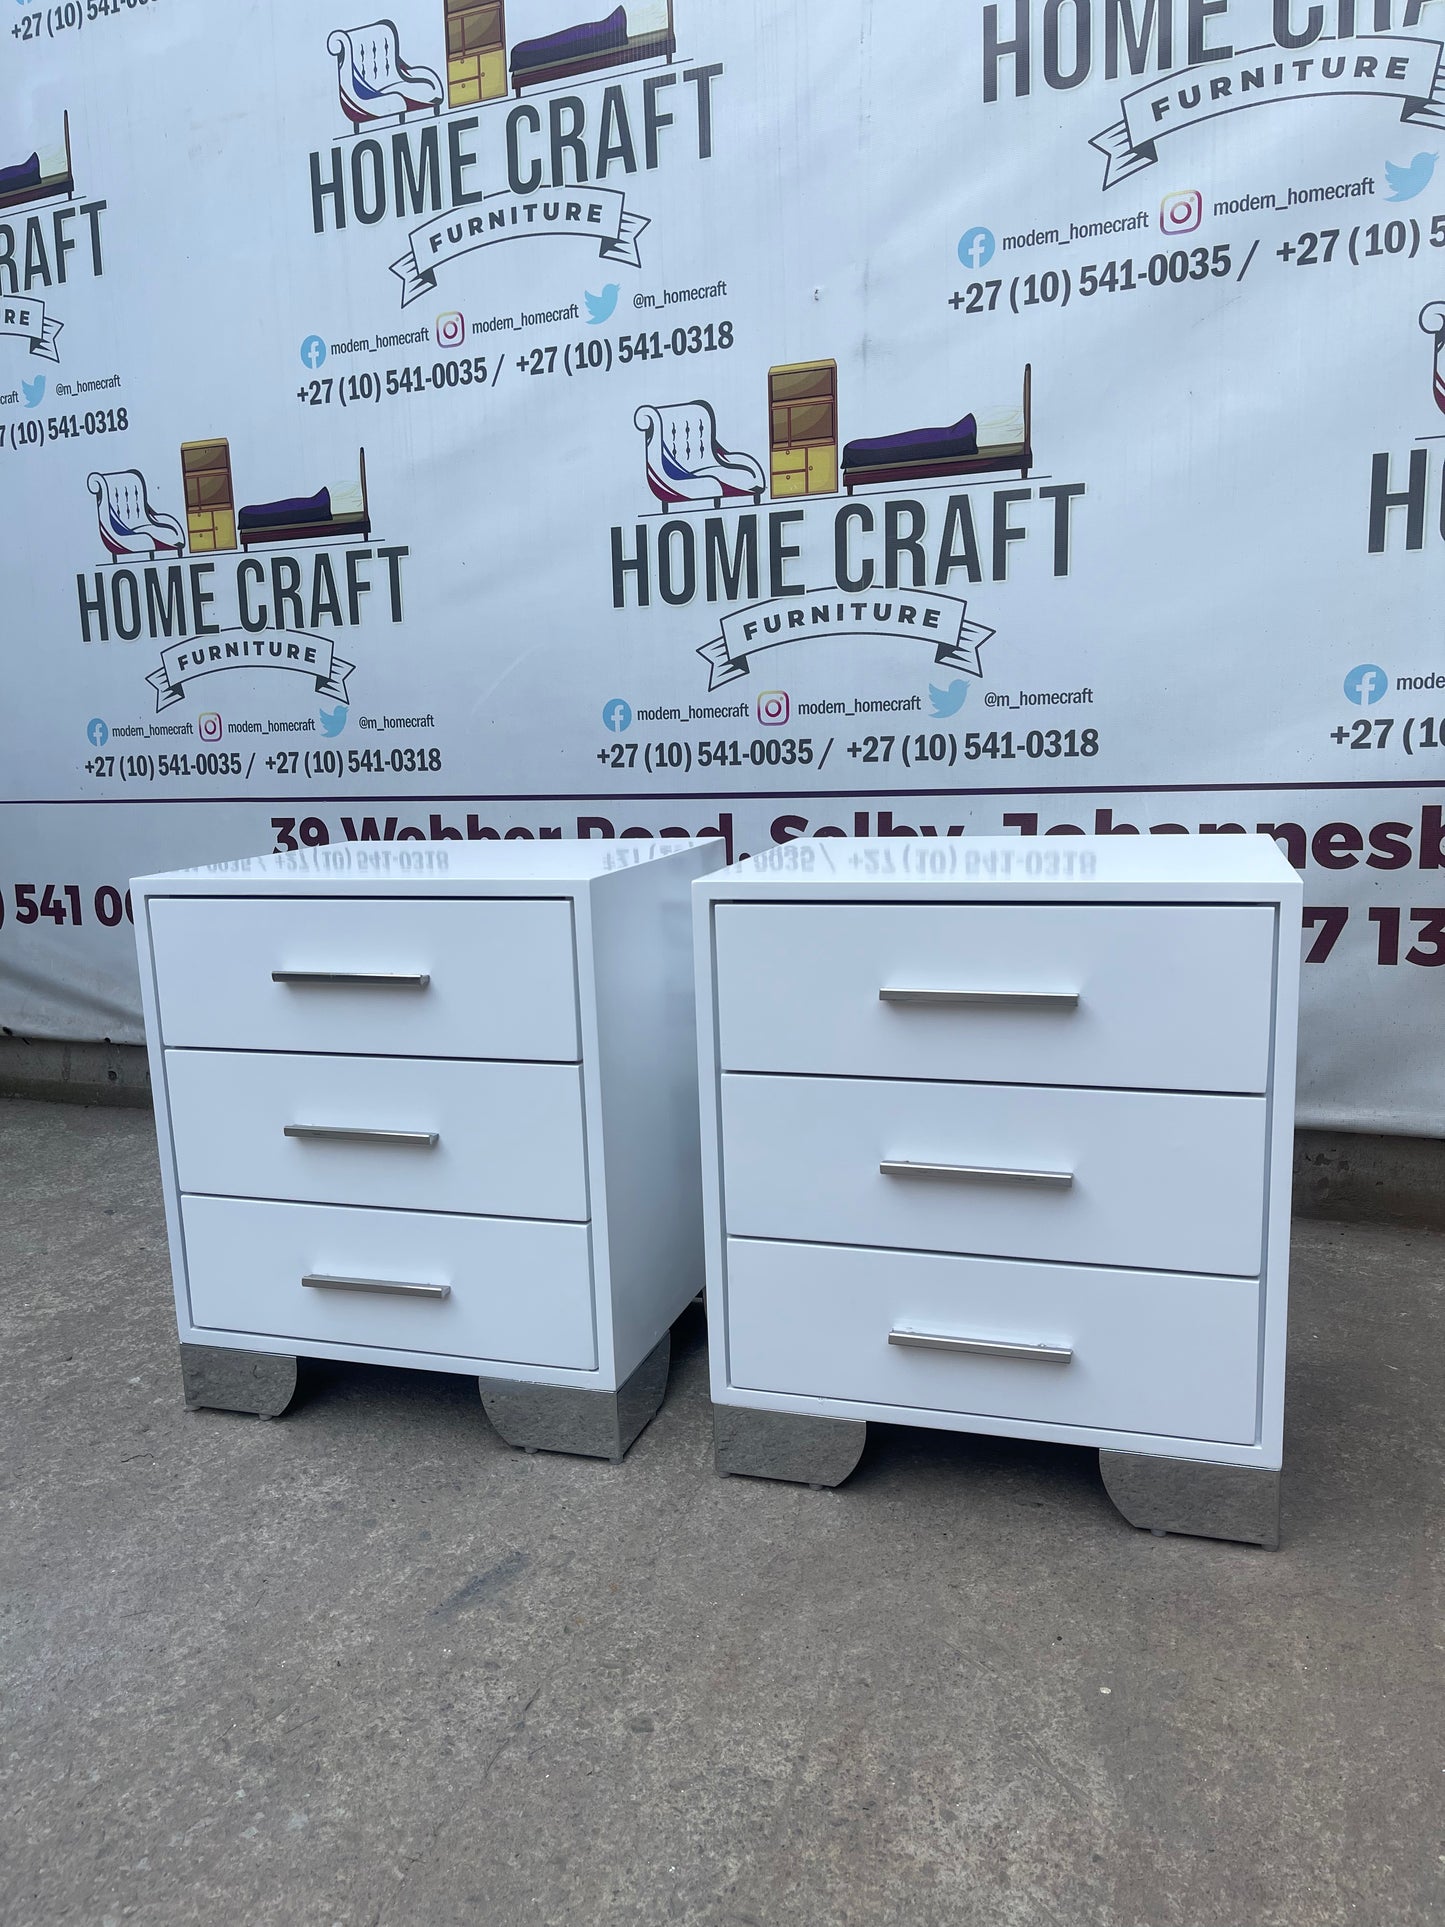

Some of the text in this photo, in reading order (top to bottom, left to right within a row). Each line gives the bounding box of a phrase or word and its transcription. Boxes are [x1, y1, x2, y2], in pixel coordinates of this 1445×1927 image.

[11, 12, 42, 40] +27
[47, 1, 82, 38] (10)
[983, 0, 1233, 103] HOME
[1151, 56, 1409, 122] FURNITURE
[309, 63, 723, 236] HOME CRAFT
[429, 202, 602, 253] FURNITURE
[948, 280, 1002, 314] +27
[1010, 269, 1071, 314] (10)
[1079, 244, 1231, 296] 541-0035
[1236, 240, 1260, 281] /
[1276, 229, 1340, 266] +27
[1349, 219, 1420, 265] (10)
[633, 281, 727, 309] @m_homecraft
[56, 374, 121, 396] @m_homecraft
[297, 321, 733, 407] +27 (10) 541-0035 / +27 (10) 541-0318
[11, 420, 44, 450] (10)
[48, 407, 128, 440] 541-0318
[611, 483, 1085, 608] HOME CRAFT
[77, 546, 409, 642] HOME CRAFT
[743, 603, 940, 641] FURNITURE
[178, 641, 316, 671] FURNITURE
[985, 688, 1093, 709] @m_homecraft
[359, 714, 435, 731] @m_homecraft
[1330, 716, 1445, 756] +27 (1
[85, 748, 441, 781] +27 (10) 541-0035 / +27 (10) 541-0318
[597, 729, 1099, 773] +27 (10) 541-0035 / +27 (10) 541-0318
[15, 884, 82, 925] 541
